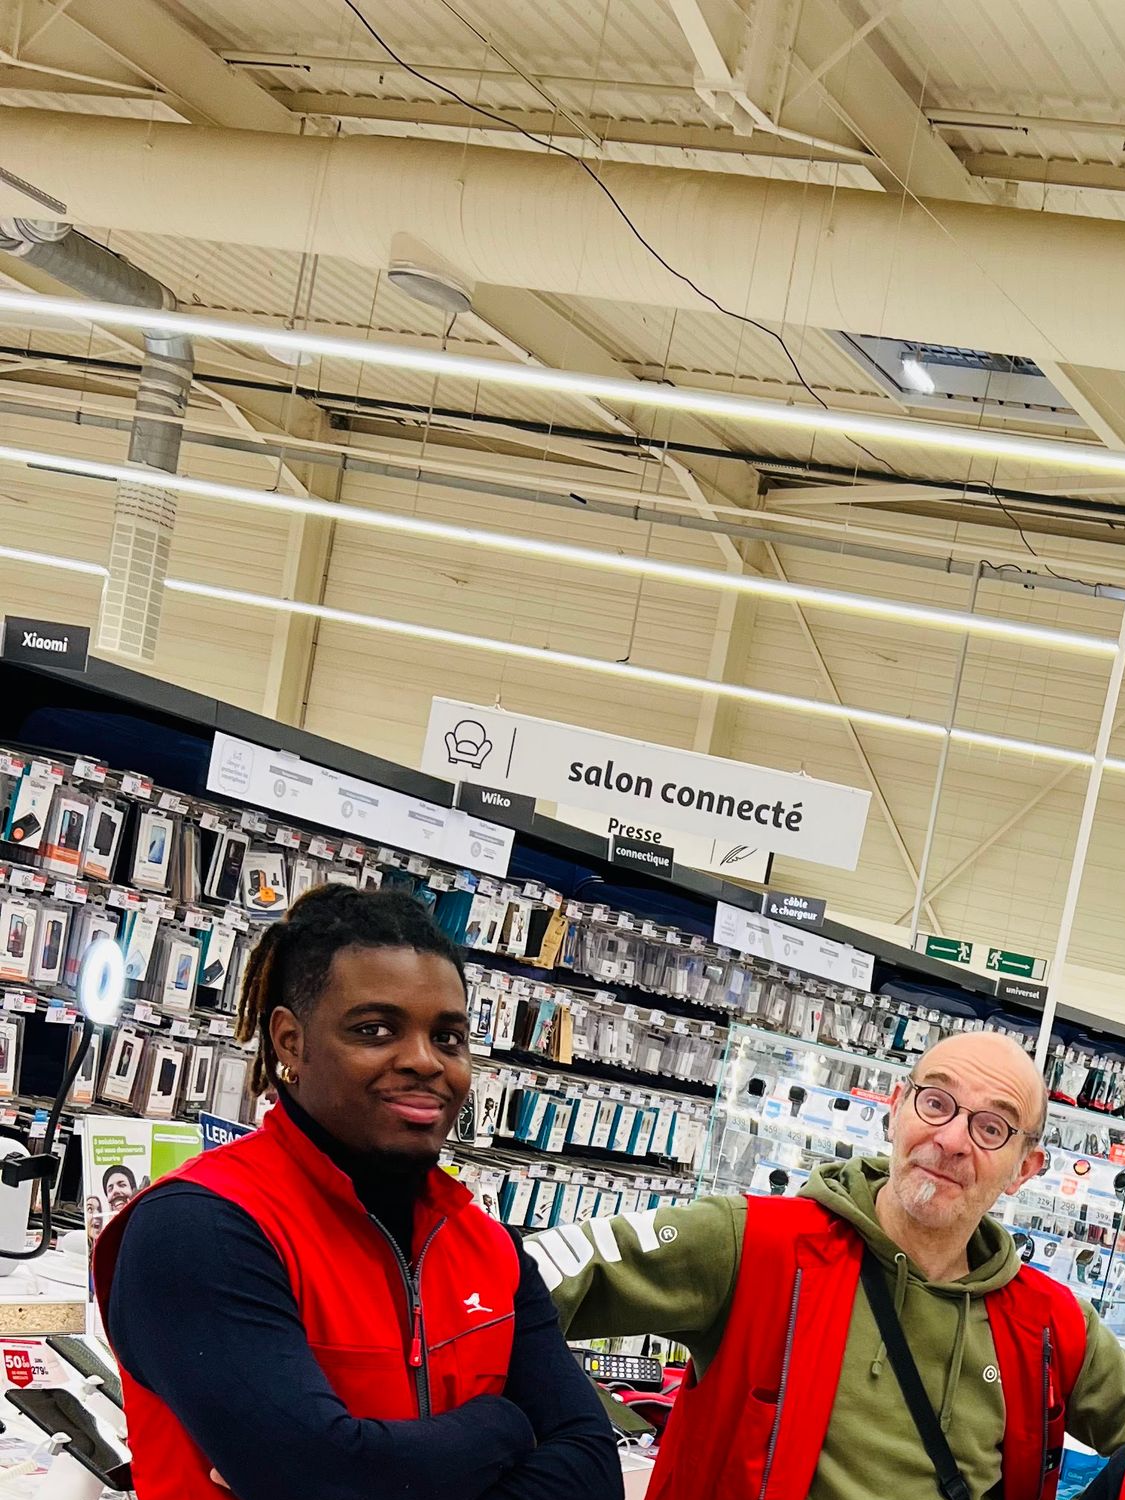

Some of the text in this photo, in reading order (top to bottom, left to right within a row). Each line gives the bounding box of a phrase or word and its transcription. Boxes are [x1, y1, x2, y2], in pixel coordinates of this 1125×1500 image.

[22, 631, 69, 653] Xiaomi
[481, 791, 511, 808] Wiko
[568, 760, 803, 832] salon connecté
[608, 817, 662, 844] Presse
[616, 846, 670, 867] connectique
[783, 896, 808, 909] câble
[779, 906, 818, 921] chargeur
[1006, 986, 1040, 1000] universel
[206, 1123, 241, 1144] LEBA
